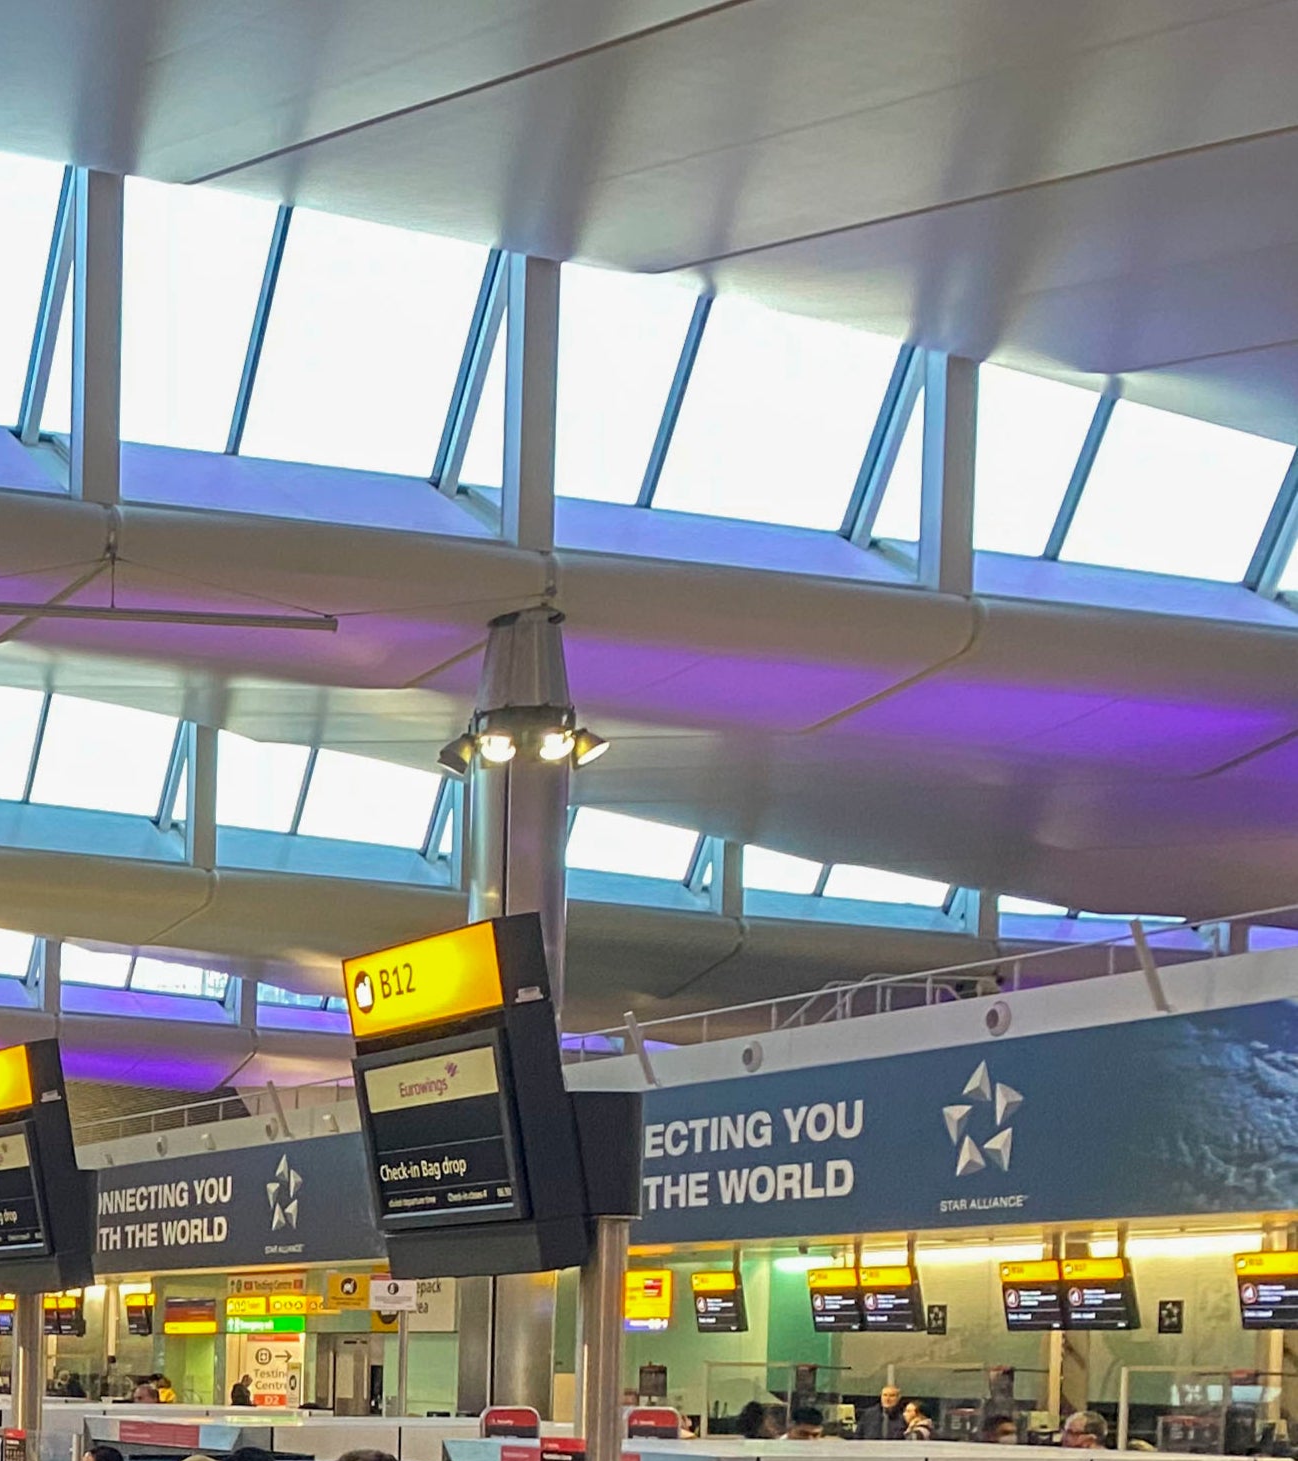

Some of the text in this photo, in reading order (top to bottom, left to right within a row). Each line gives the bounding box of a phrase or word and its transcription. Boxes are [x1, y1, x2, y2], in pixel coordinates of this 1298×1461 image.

[379, 962, 416, 999] B12
[399, 1076, 449, 1099] Eurowings
[644, 1099, 864, 1159] ECTING YOU
[379, 1156, 467, 1182] Check-in Bag drop
[193, 1175, 233, 1205] YOU
[642, 1159, 854, 1211] THE WORLD
[939, 1195, 1025, 1213] STAR ALLIANCE
[124, 1222, 159, 1249] THE
[161, 1216, 228, 1247] WORLD
[264, 1395, 280, 1405] D2
